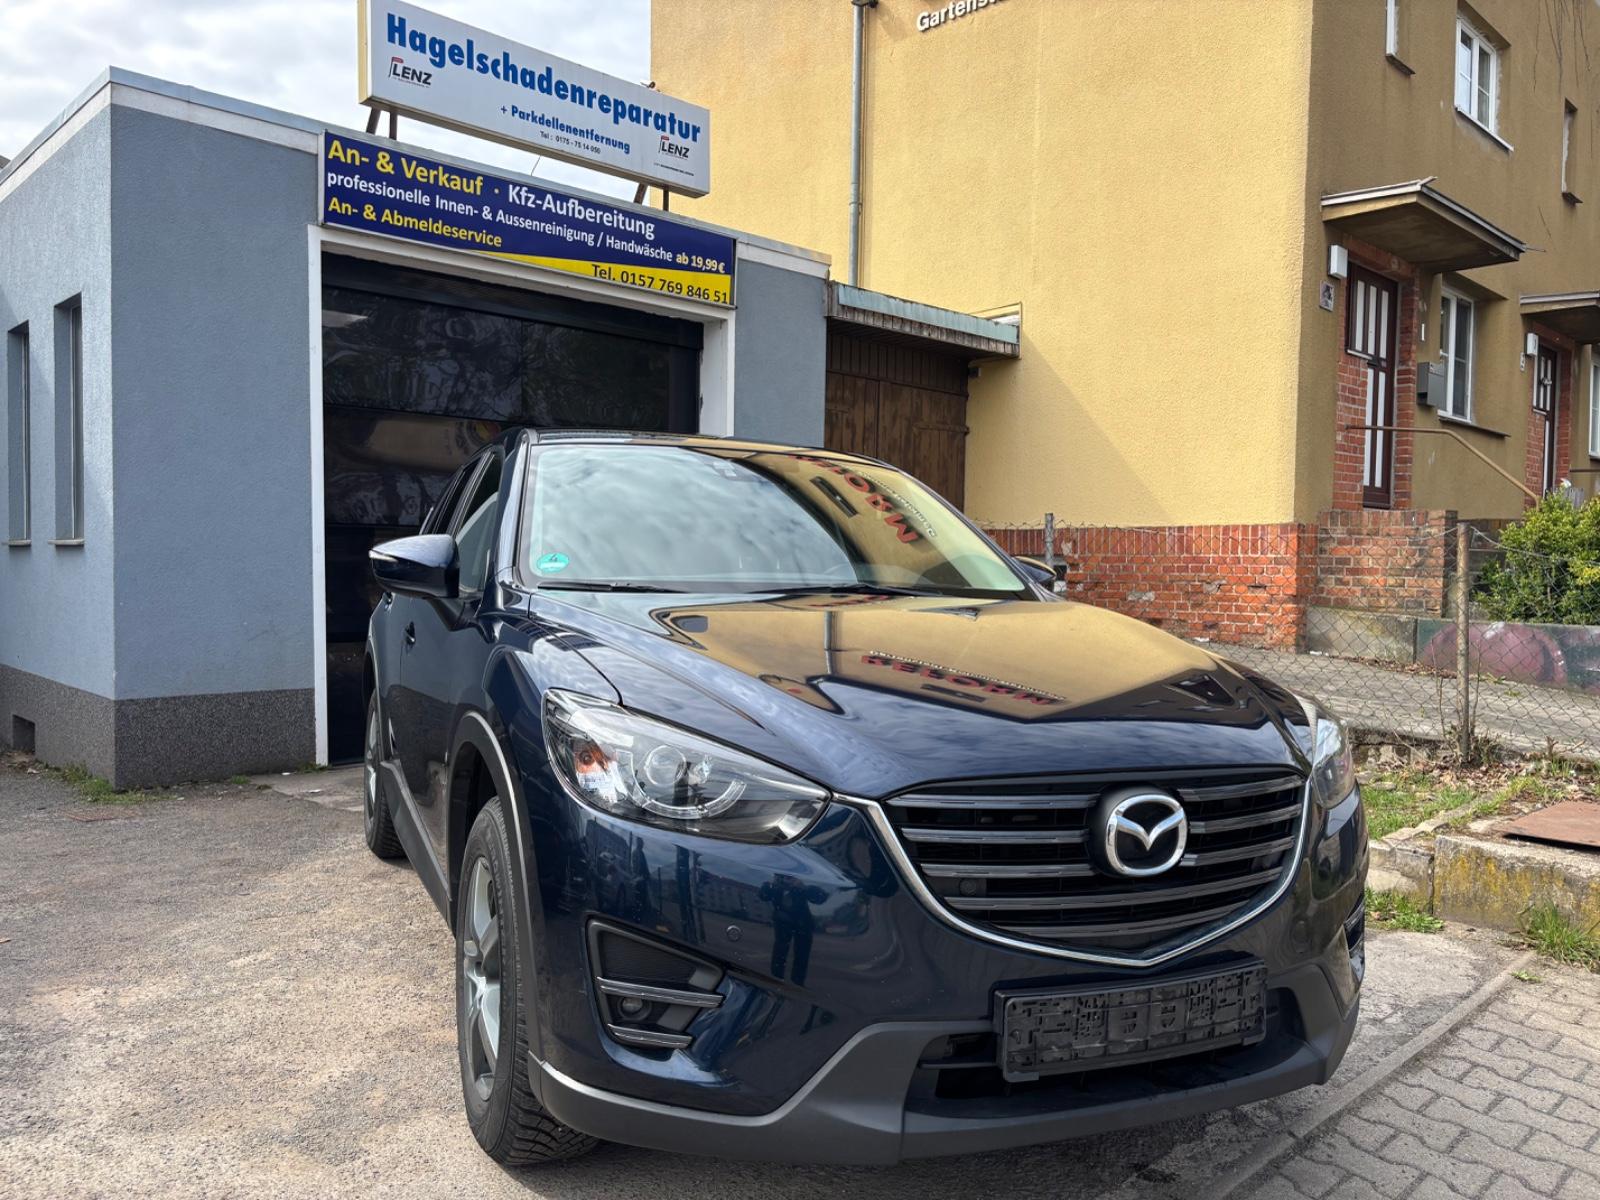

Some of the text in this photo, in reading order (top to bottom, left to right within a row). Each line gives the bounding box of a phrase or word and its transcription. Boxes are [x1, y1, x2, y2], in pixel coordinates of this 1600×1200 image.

[916, 0, 996, 32] Gartens
[387, 13, 701, 143] Hagelschadenreparatur
[392, 63, 433, 86] LENZ
[511, 105, 631, 155] Parkdellenentfernung
[660, 141, 690, 159] LENZ
[328, 140, 655, 241] An- & Verkauf Kfz-Aufbereitung
[327, 172, 430, 206] professionelle
[435, 195, 479, 217] Innen-
[482, 205, 493, 221] &
[496, 210, 595, 247] Aussenreinigung
[606, 235, 673, 262] Handwäsche
[675, 252, 689, 266] ab
[328, 197, 503, 248] An- & Abmeldeservice
[592, 264, 728, 305] Tel. 0157 769 846 51
